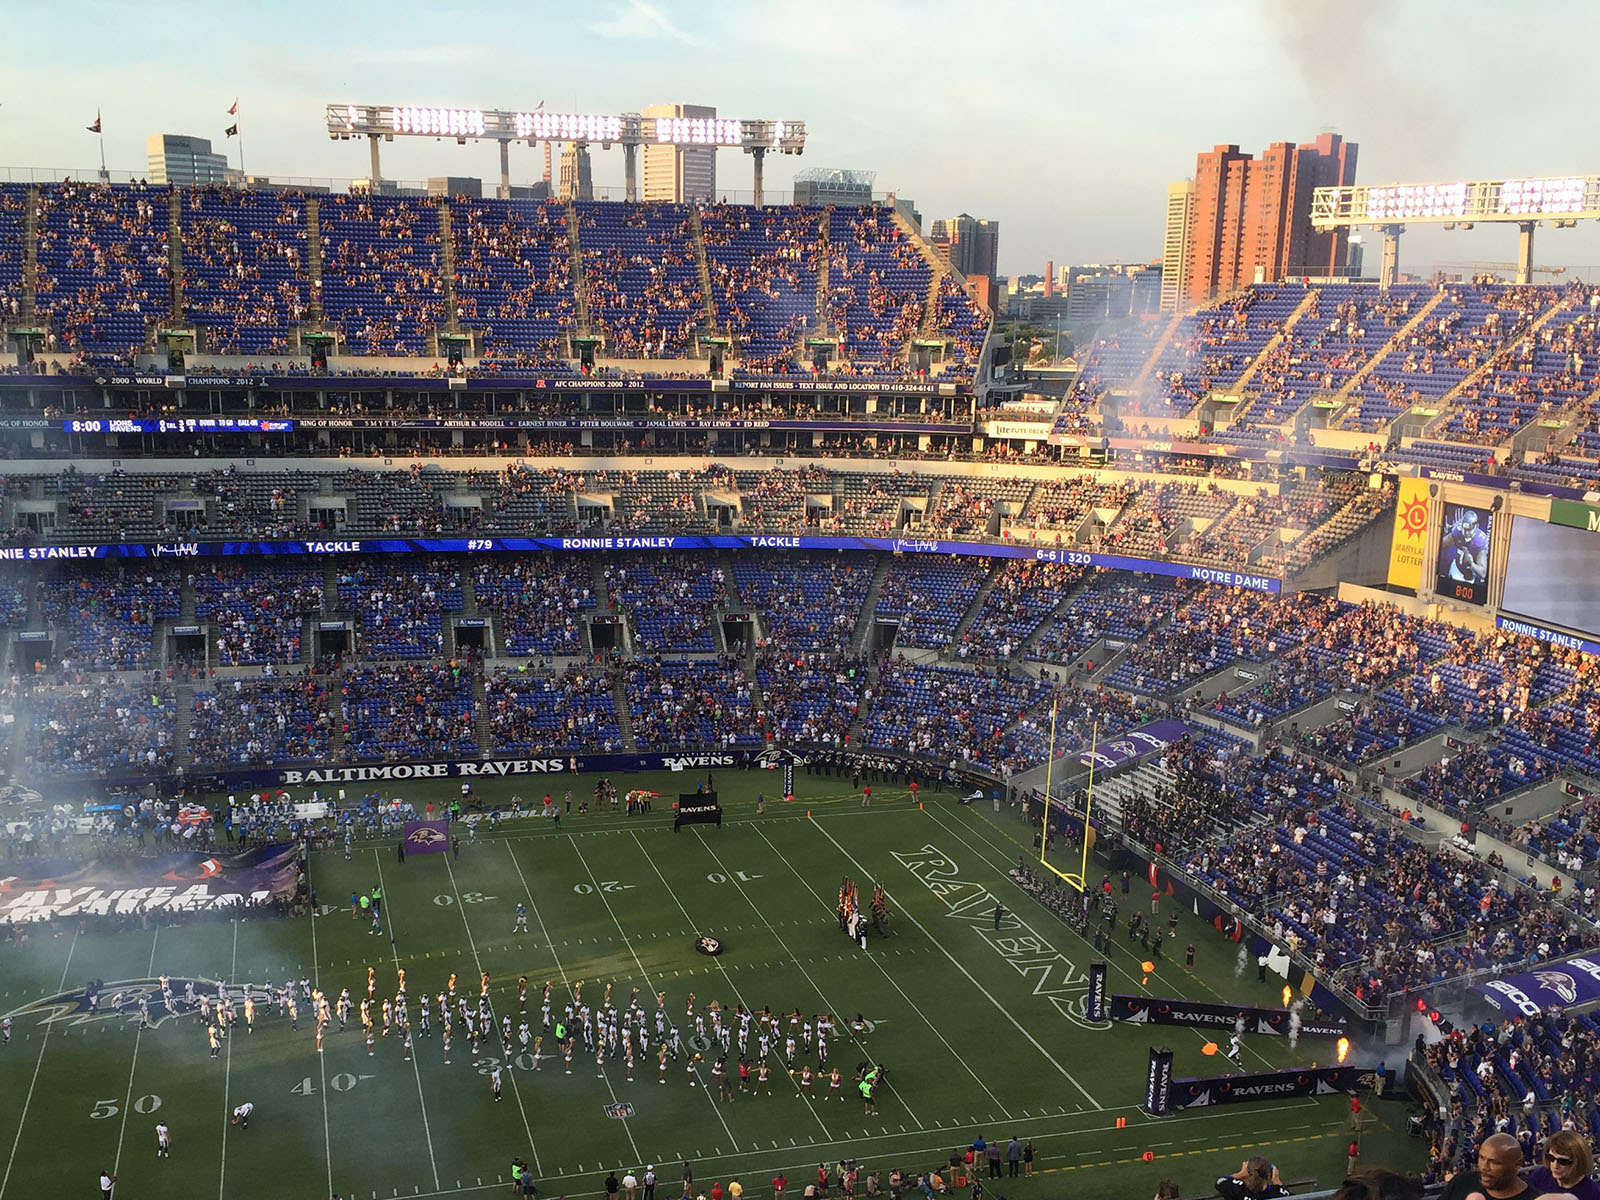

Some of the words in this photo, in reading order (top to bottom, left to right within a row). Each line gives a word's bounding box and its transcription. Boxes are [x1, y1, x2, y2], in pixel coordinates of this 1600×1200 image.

[111, 377, 130, 385] 2000
[136, 377, 163, 385] WORLD
[188, 377, 230, 385] CHAMPIONS
[236, 378, 254, 386] 2012
[735, 381, 758, 390] REPORT
[760, 381, 772, 390] FAN
[799, 382, 815, 390] TEXT
[816, 382, 833, 390] ISSUE
[834, 382, 848, 390] AND
[849, 382, 879, 391] LOCATION
[881, 383, 890, 391] TO
[72, 421, 101, 432] 8:00
[479, 420, 505, 428] MODELL
[518, 420, 545, 428] EARNEST
[547, 420, 567, 428] BYNER
[580, 420, 599, 428] PETER
[1429, 472, 1464, 482] RAVENS
[306, 542, 360, 552] TACKLE
[468, 540, 492, 550] #79
[562, 539, 613, 549] RONNIE
[616, 537, 675, 548] STANLEY
[751, 537, 800, 547] TACKLE
[29, 546, 97, 558] STANLEY
[1036, 550, 1056, 560] 6-6
[1068, 553, 1091, 564] 320
[1192, 568, 1231, 585] NOTRE
[1234, 575, 1269, 590] DAME
[1456, 585, 1473, 600] 8:00
[1502, 619, 1537, 637] RONNIE
[1539, 629, 1584, 650] STANLEY
[661, 756, 734, 768] RAVENS
[284, 764, 448, 783] BALTIMORE
[456, 758, 564, 777] RAVENS
[680, 804, 716, 813] RAVENS
[1092, 971, 1104, 1019] RAVENS
[1485, 980, 1542, 1017] GEICO
[1171, 1011, 1236, 1026] RAVENS
[1302, 1025, 1343, 1036] RAVENS
[1146, 1059, 1157, 1108] RAVENS
[1158, 1060, 1170, 1113] RAVENS
[1232, 1081, 1295, 1098] RAVENS
